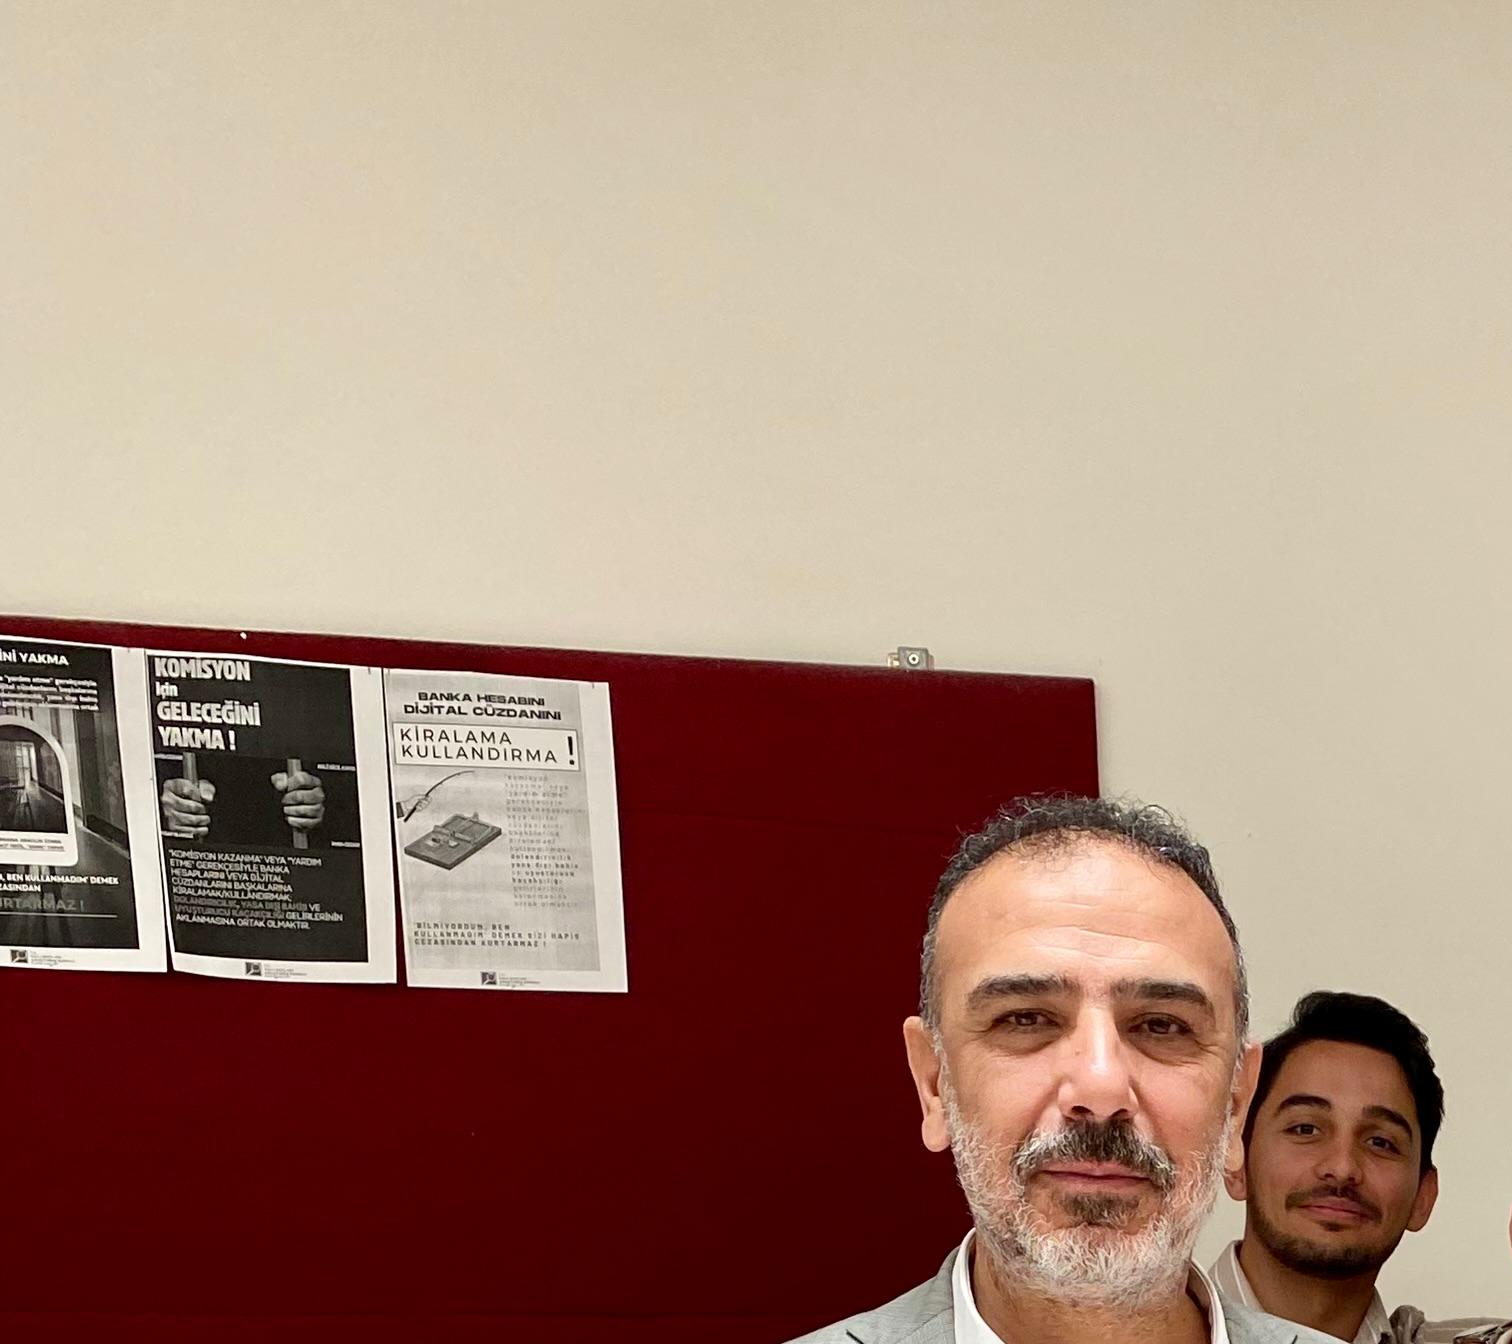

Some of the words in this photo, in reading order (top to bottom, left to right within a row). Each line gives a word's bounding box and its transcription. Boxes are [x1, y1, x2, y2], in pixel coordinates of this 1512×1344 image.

[19, 652, 69, 665] YAKMA
[154, 658, 250, 681] KOMİSYON
[418, 692, 472, 702] BANKA
[477, 694, 544, 706] HESABINI
[157, 700, 261, 726] GELECEĞİNİ
[404, 702, 468, 715] DİJİTAL
[473, 705, 561, 720] CÜZDANINI
[158, 726, 225, 750] YAKMA
[229, 730, 236, 750] !
[400, 726, 512, 744] KİRALAMA
[402, 745, 557, 763] KULLANDIRMA
[90, 877, 119, 885] DEMEK
